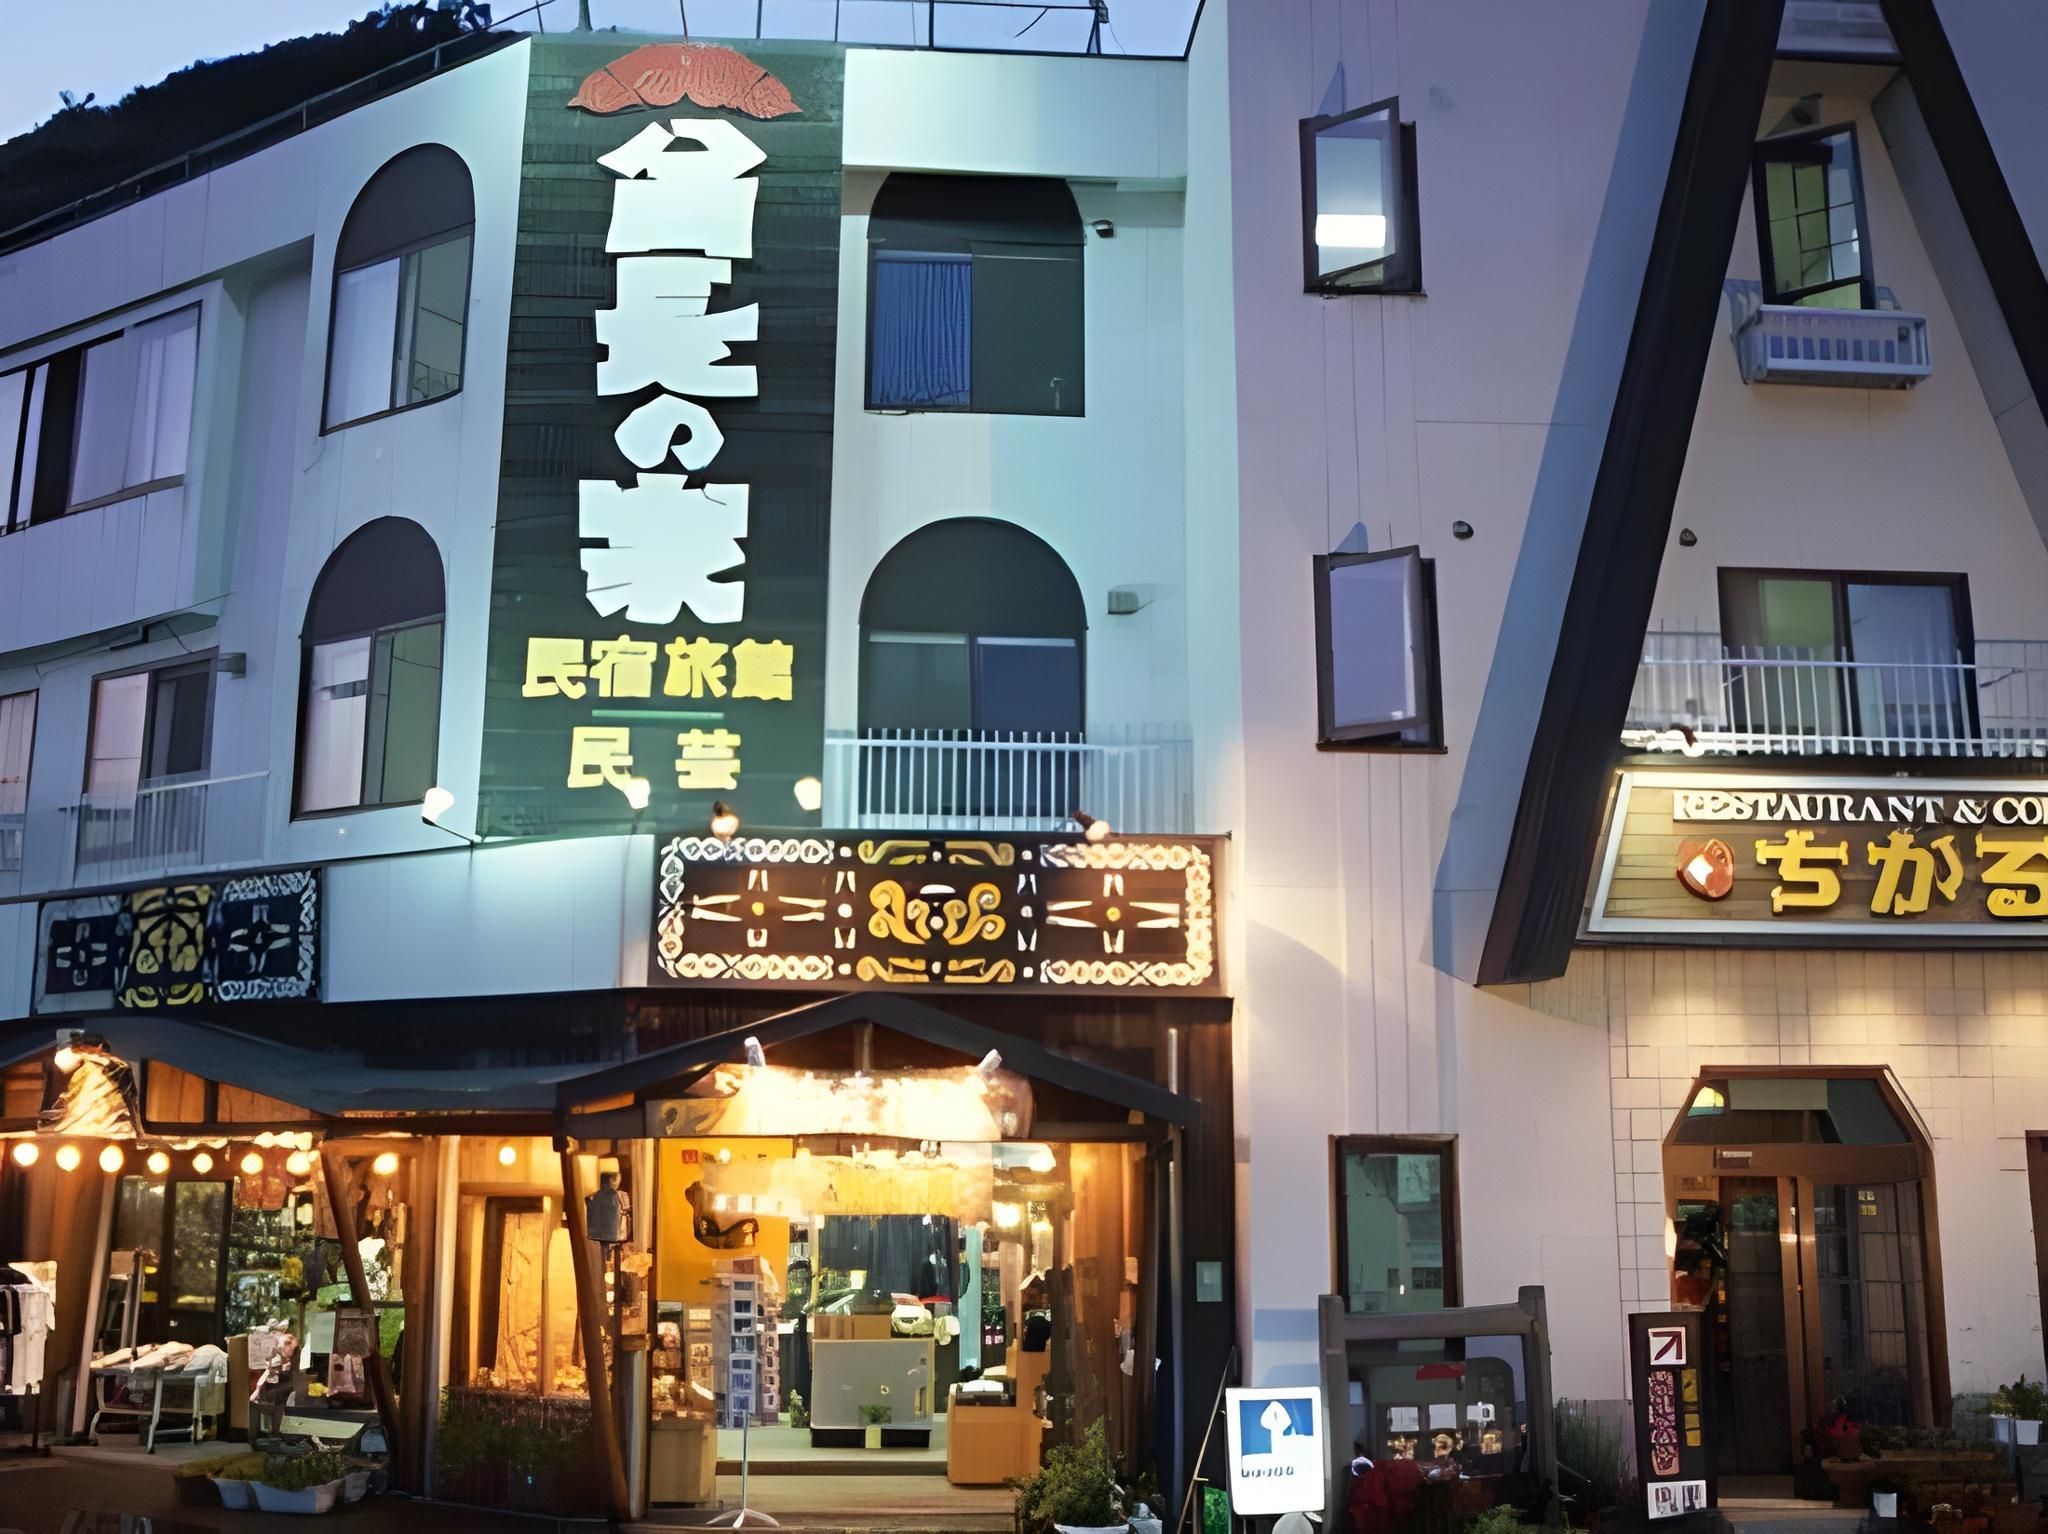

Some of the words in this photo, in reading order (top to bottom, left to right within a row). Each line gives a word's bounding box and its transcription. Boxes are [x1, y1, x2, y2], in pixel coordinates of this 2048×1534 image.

[521, 634, 794, 701] 民宿旅館
[1673, 790, 1944, 824] RESTAURANT
[1952, 799, 1988, 826] &
[1992, 796, 2048, 826] CO
